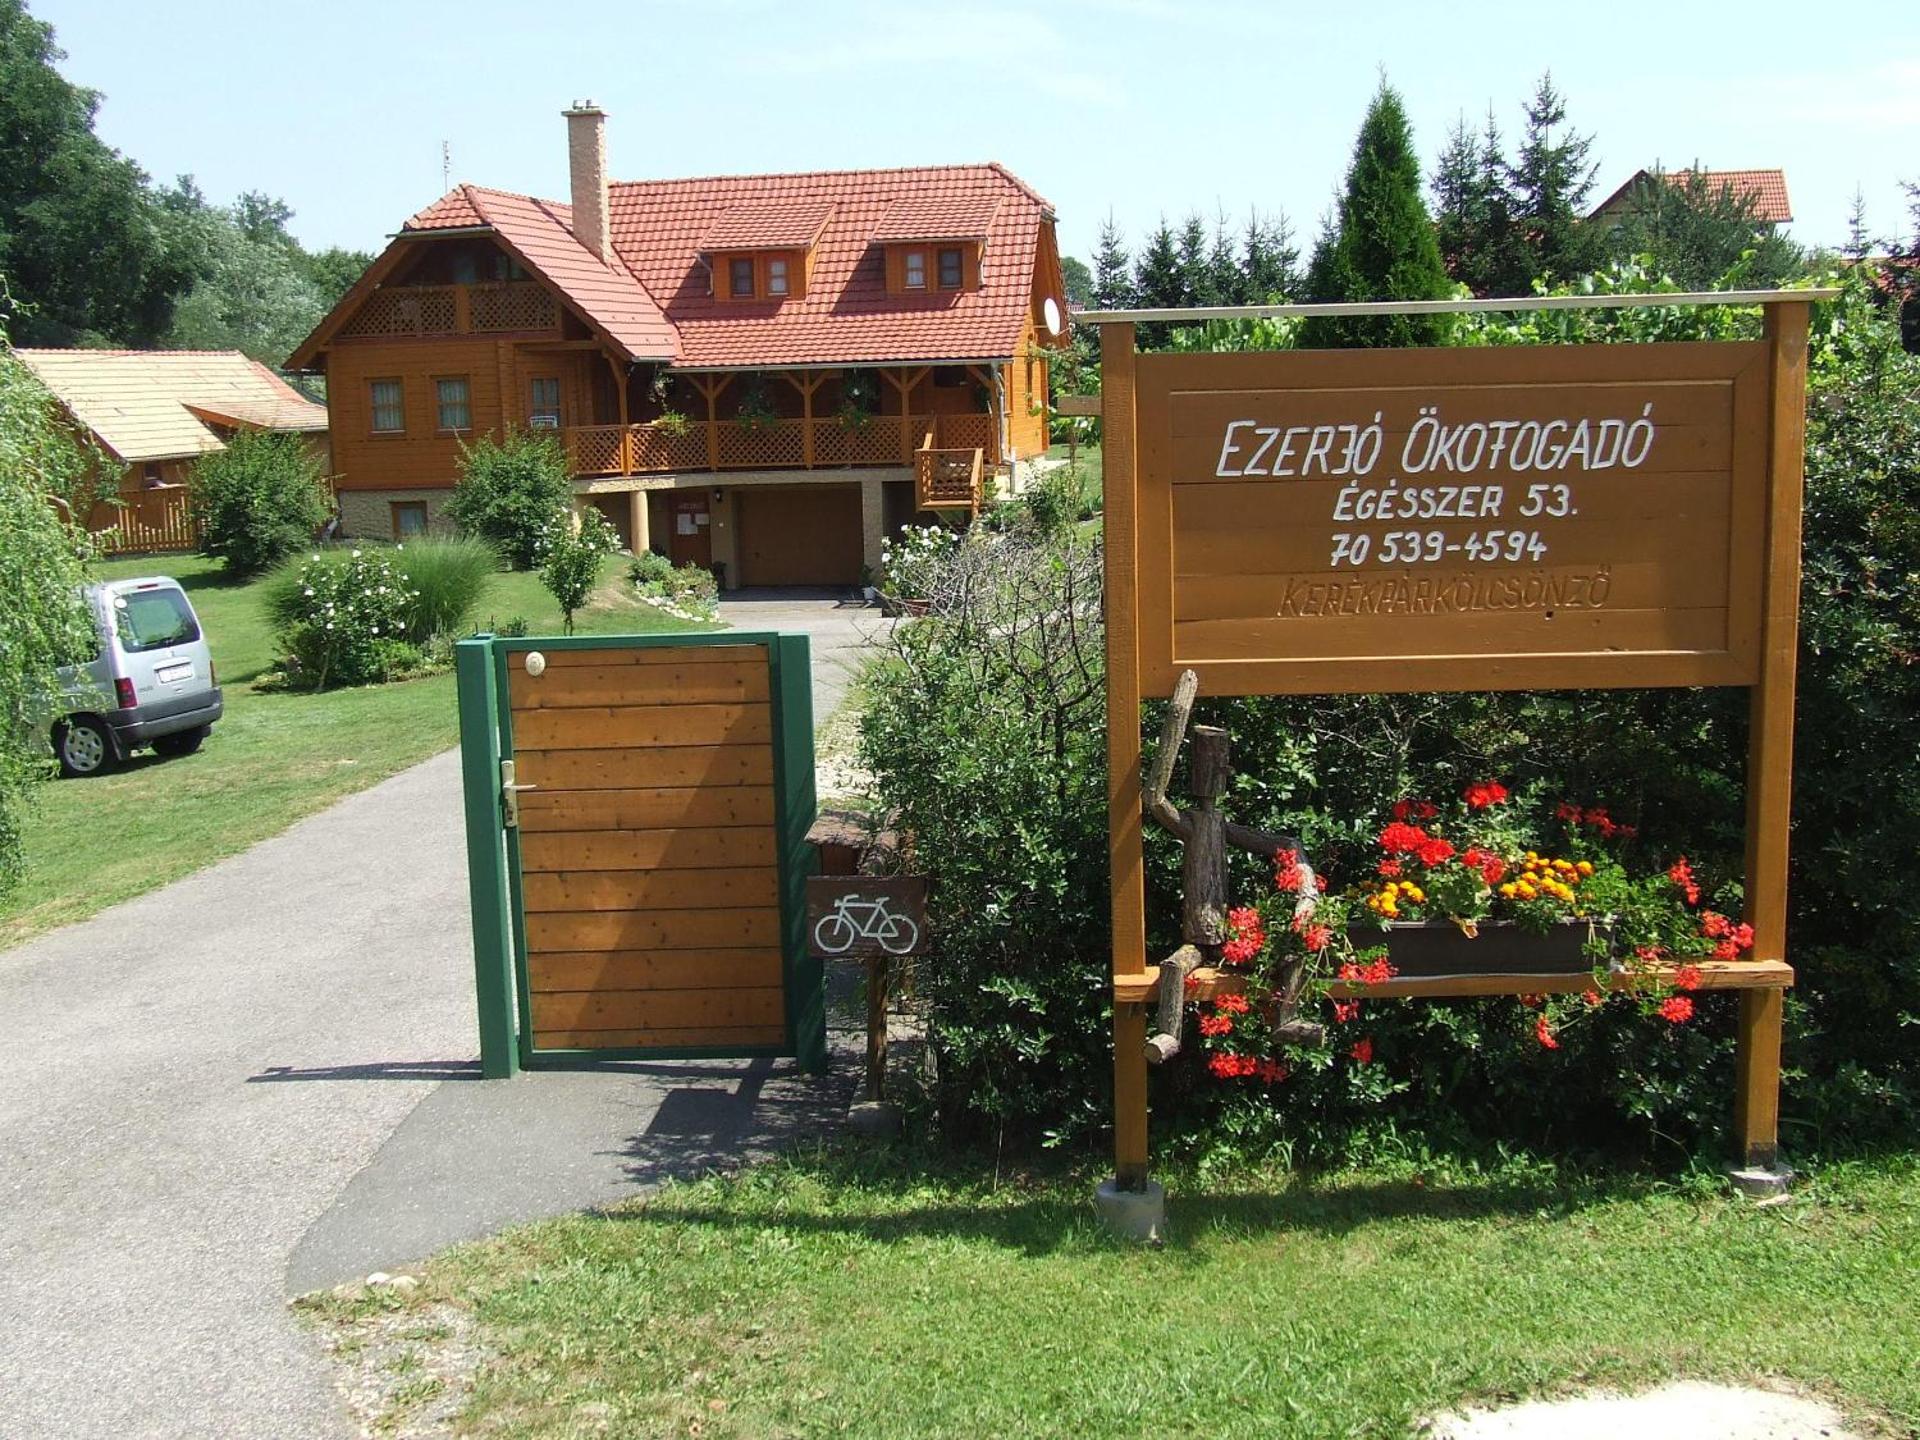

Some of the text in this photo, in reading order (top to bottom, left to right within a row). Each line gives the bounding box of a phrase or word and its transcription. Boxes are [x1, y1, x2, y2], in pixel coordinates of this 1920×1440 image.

[1216, 411, 1383, 477] EZERJÓ
[1333, 480, 1578, 521] ÉGÉSSZER 53.
[1330, 530, 1547, 566] 70 539-4594
